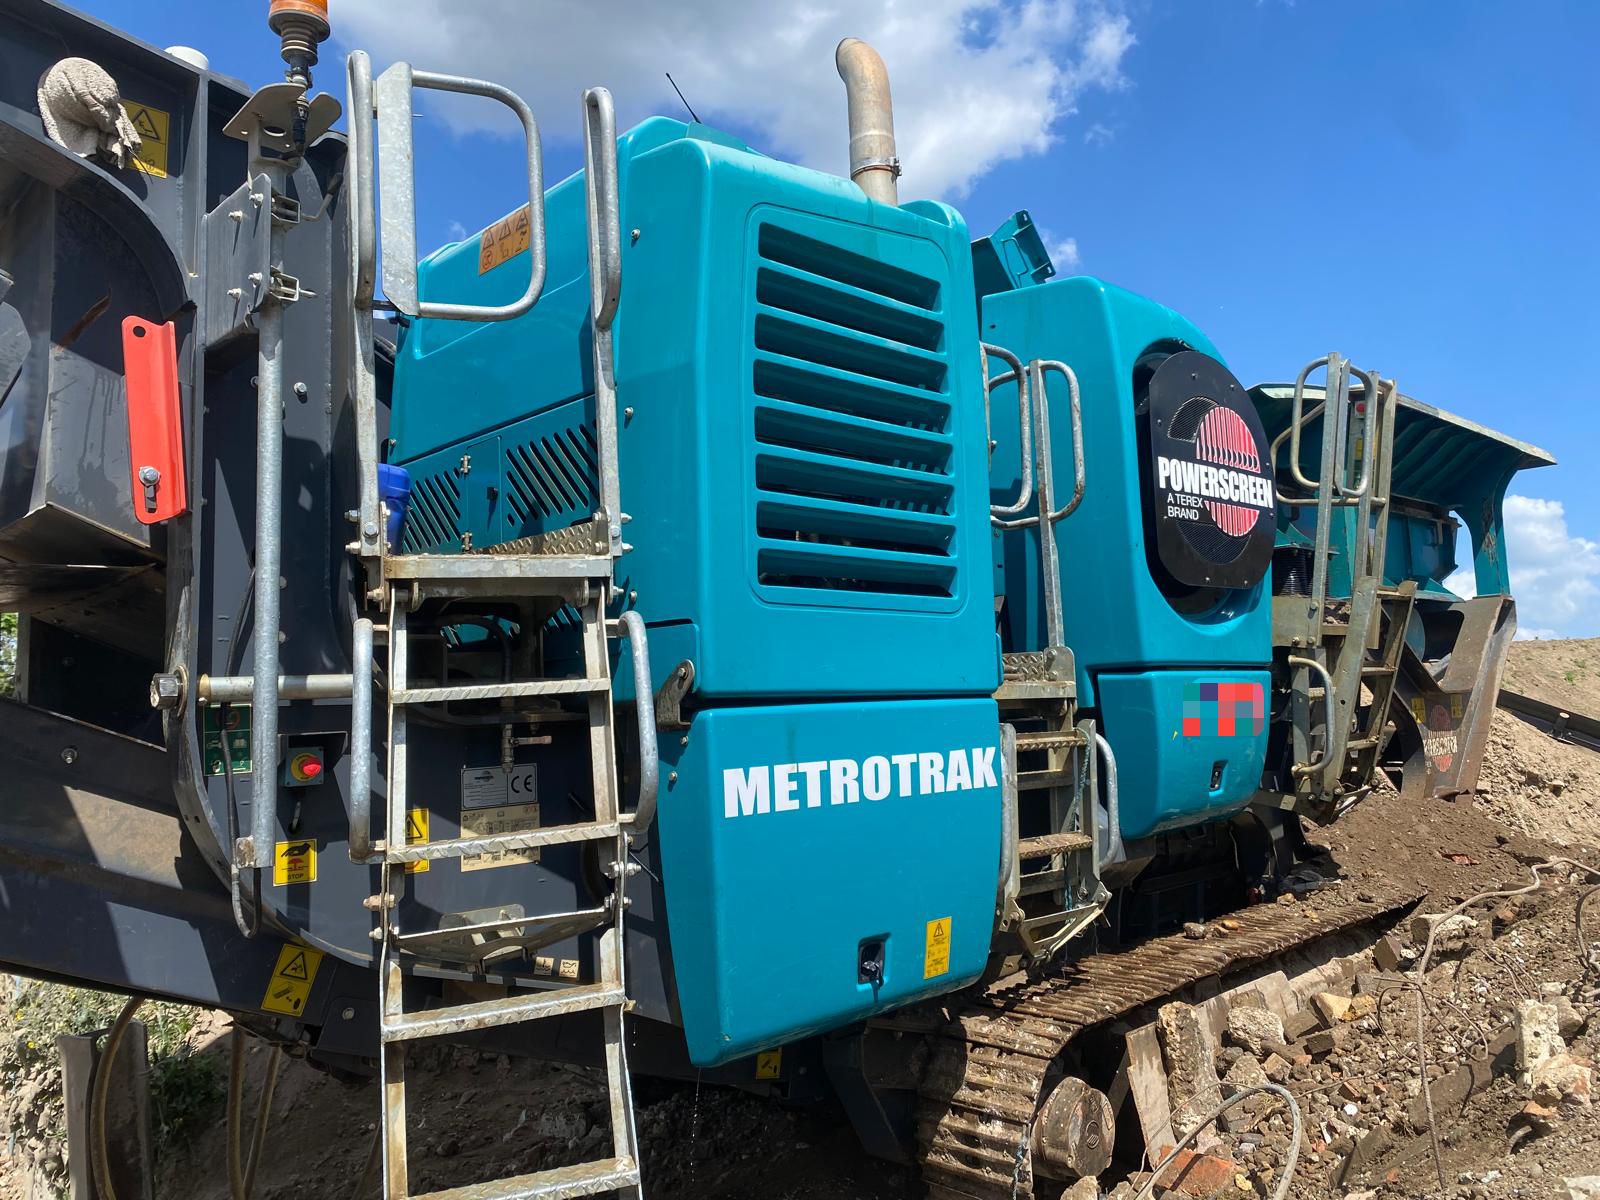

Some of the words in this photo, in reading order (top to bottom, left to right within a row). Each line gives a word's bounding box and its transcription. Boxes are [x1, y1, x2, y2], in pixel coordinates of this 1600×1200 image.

[1157, 456, 1274, 508] POWERSCREEN
[1167, 493, 1174, 504] A
[1175, 493, 1203, 508] TEREX
[1167, 506, 1199, 520] BRAND
[723, 747, 998, 818] METROTRAK
